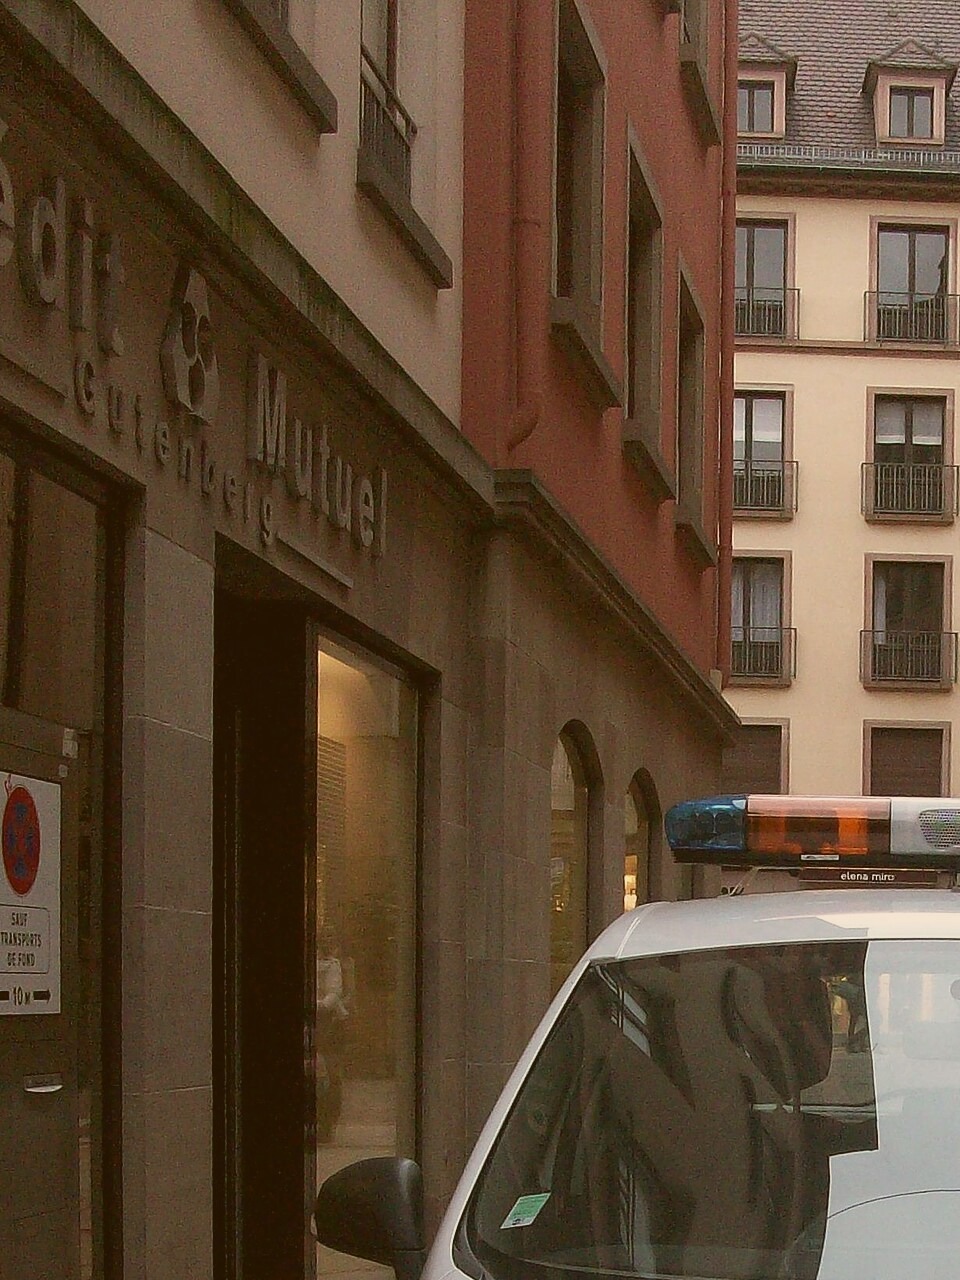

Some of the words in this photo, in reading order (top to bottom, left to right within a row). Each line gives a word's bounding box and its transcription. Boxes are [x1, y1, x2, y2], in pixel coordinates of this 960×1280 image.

[255, 353, 388, 554] Mutuel
[841, 871, 869, 881] elena
[11, 912, 28, 926] SAUF
[0, 931, 42, 948] TRANSPORTS
